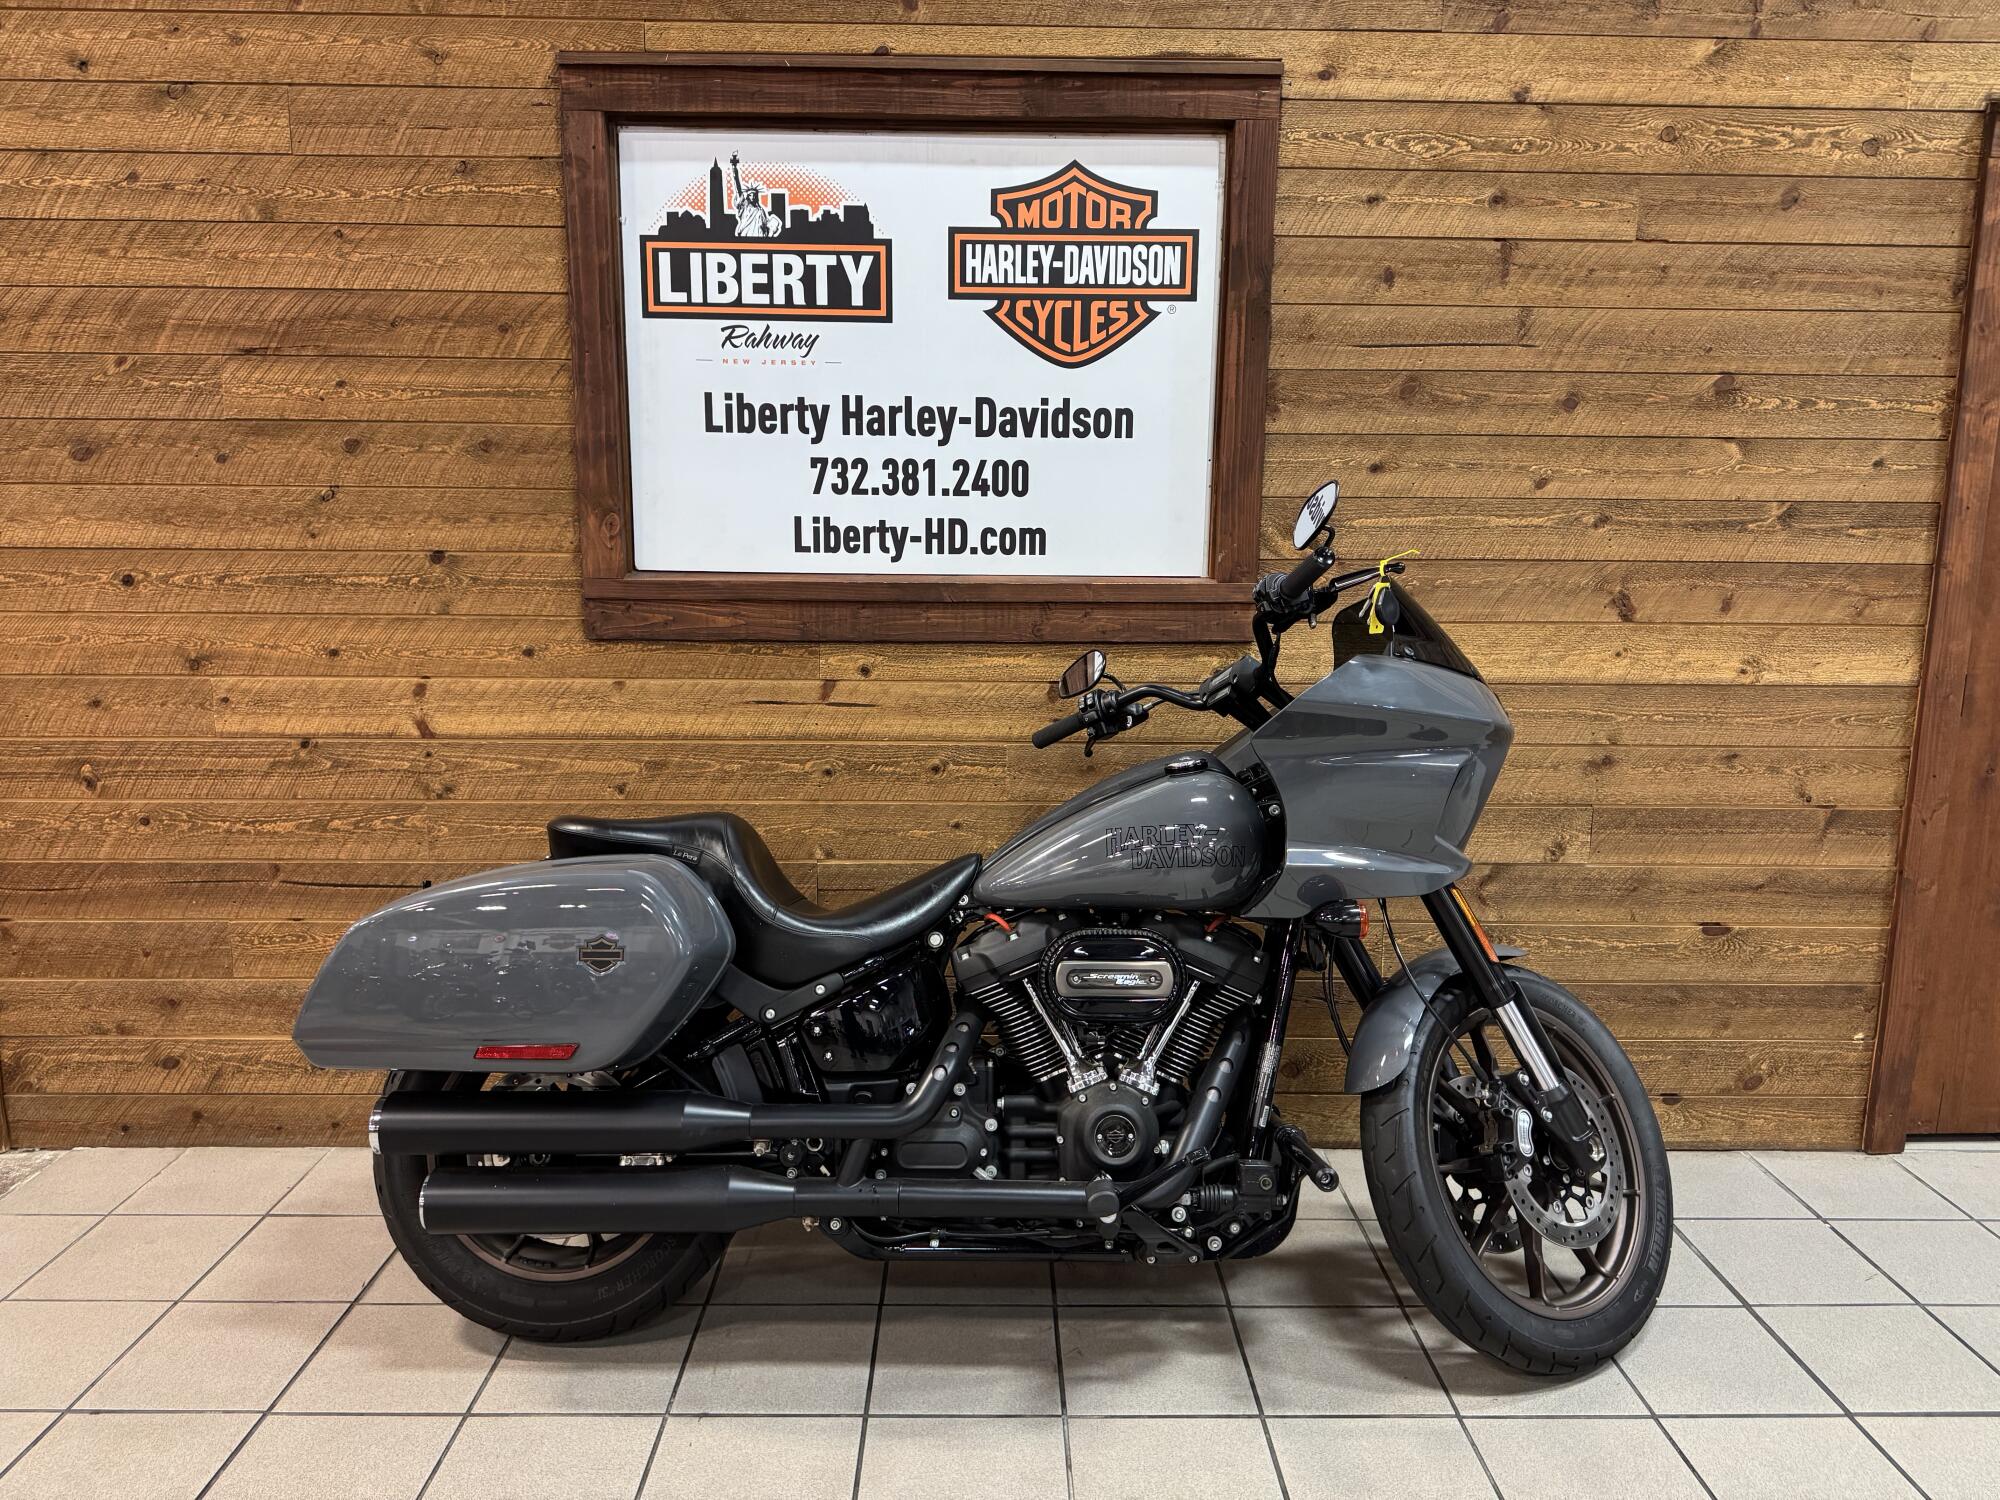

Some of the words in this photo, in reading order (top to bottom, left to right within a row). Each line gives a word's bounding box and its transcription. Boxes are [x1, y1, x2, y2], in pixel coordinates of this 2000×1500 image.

[1017, 181, 1132, 230] MOTOR
[658, 251, 874, 307] LIBERTY
[965, 243, 1182, 286] HARLEY-DAVIDSON
[720, 323, 820, 358] Rahway
[1015, 299, 1129, 352] CYCLES
[703, 391, 830, 445] Liberty
[841, 394, 1134, 447] Harley-Davidson
[810, 457, 1030, 498] 732.381.2400
[793, 515, 1047, 563] Liberty-HD.com
[1131, 845, 1246, 870] DAVIDSON
